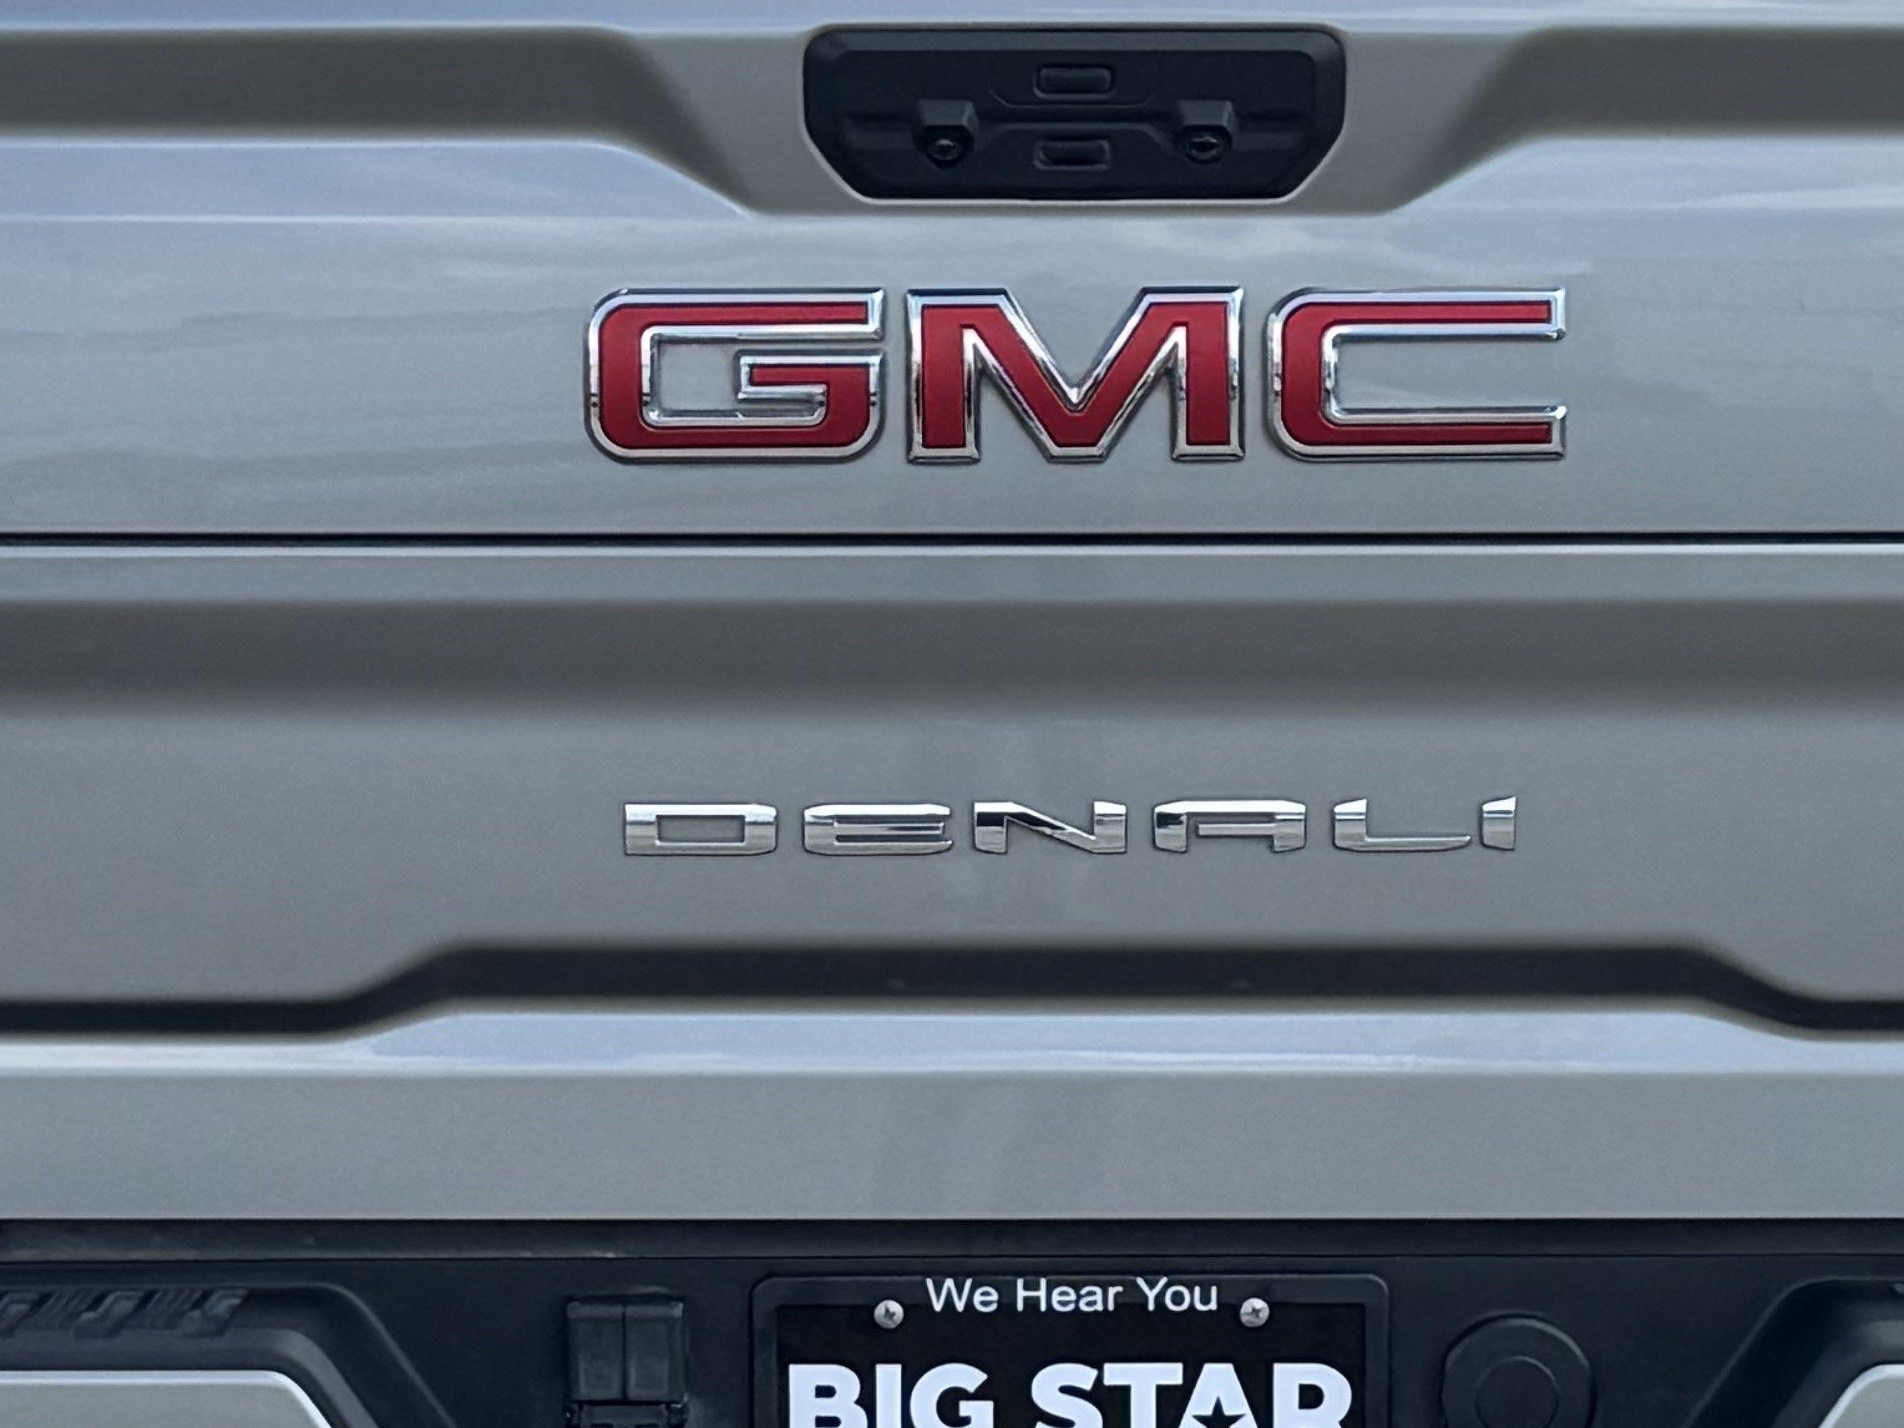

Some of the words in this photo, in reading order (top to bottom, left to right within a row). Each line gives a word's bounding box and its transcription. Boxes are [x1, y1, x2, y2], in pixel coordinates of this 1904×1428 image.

[584, 286, 1568, 464] GMC
[623, 795, 1518, 856] DENALI
[926, 1277, 999, 1313] We
[1016, 1277, 1124, 1312] Hear
[1135, 1276, 1218, 1312] You
